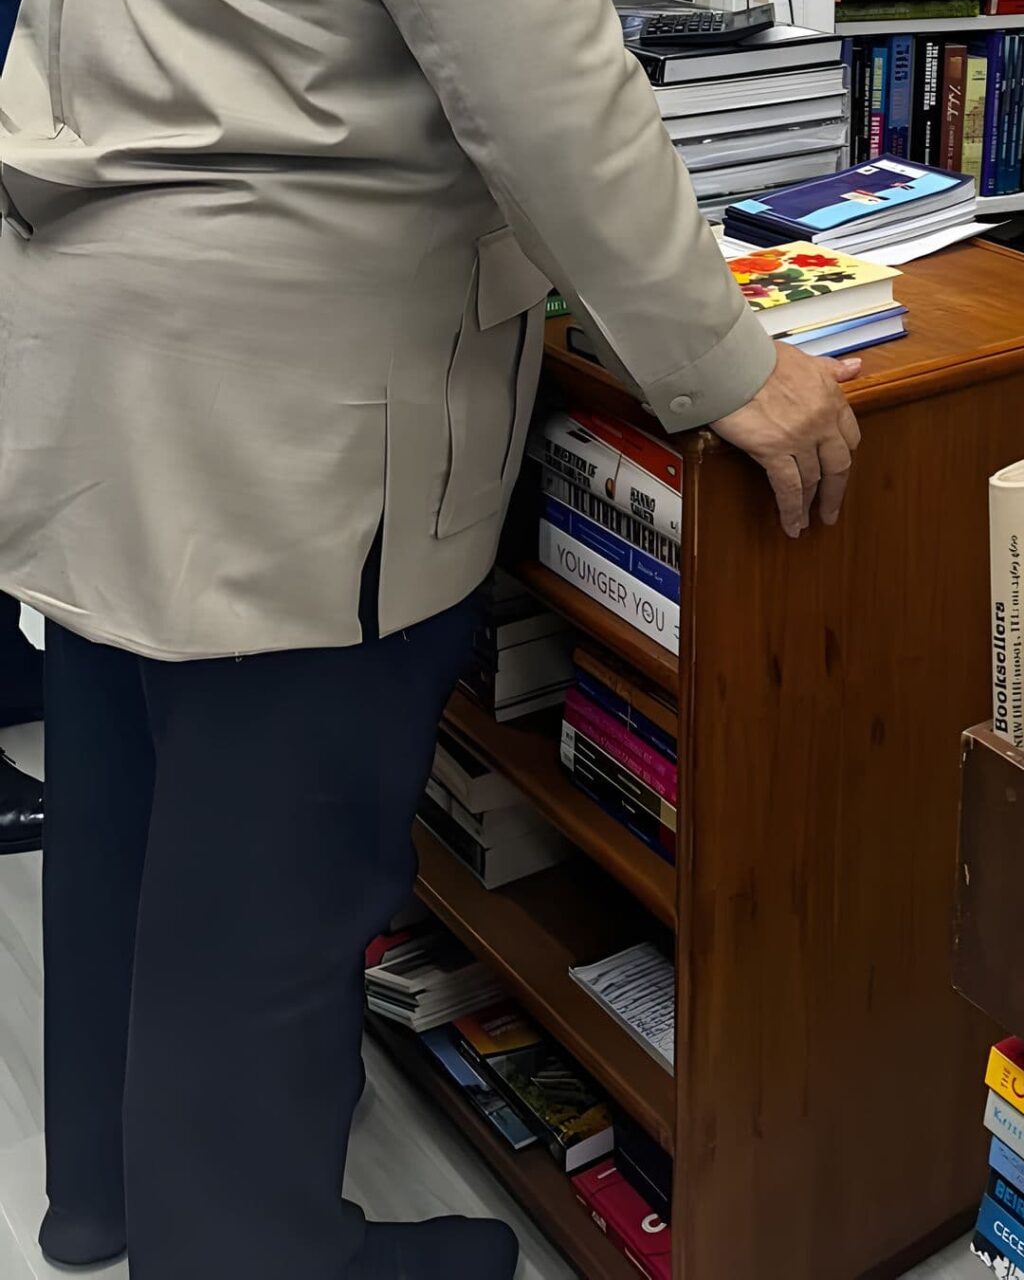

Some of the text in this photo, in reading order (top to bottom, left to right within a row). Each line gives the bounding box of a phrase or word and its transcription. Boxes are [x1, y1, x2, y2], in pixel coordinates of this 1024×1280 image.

[556, 543, 666, 632] YOUNGER YOU
[993, 600, 1008, 735] Booksellers
